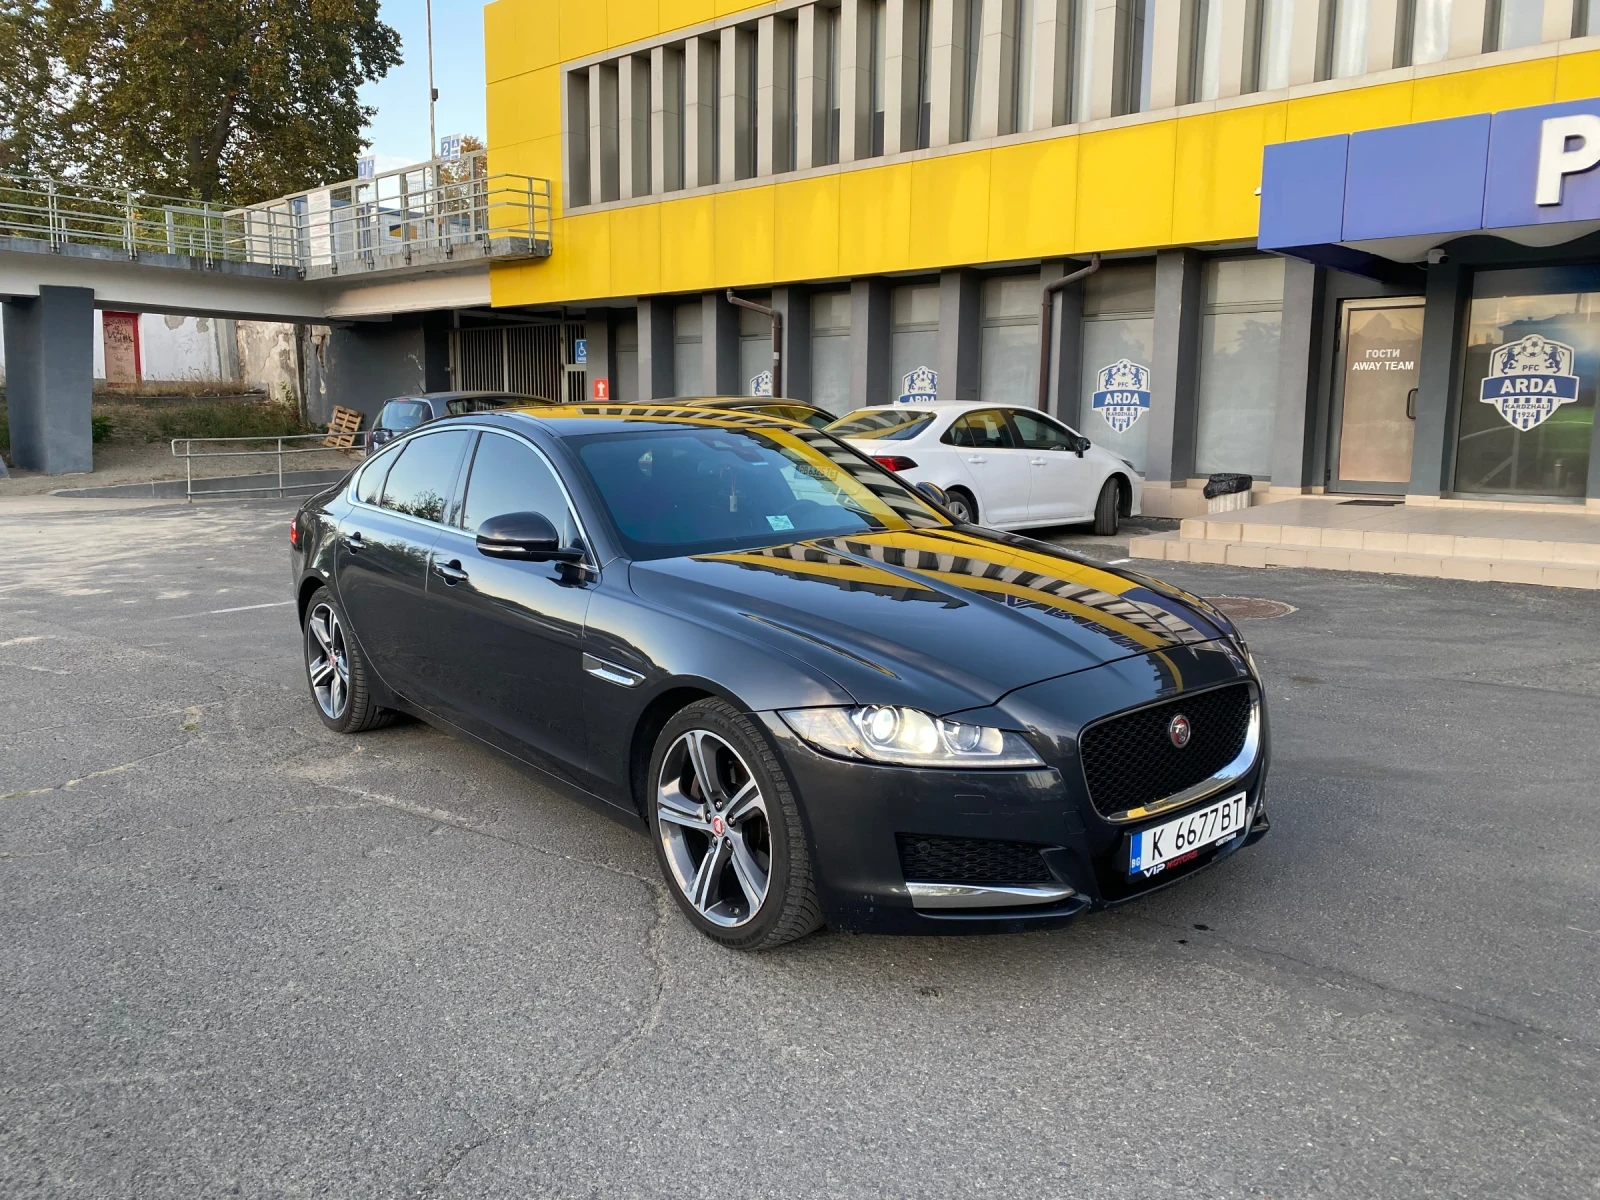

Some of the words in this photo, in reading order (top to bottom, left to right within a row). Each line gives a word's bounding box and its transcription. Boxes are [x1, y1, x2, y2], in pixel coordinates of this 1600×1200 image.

[442, 142, 449, 156] 2
[1535, 114, 1600, 207] P
[360, 162, 366, 176] 1
[1365, 348, 1401, 359] ГОСТИ
[1352, 361, 1383, 371] AWAY
[1384, 360, 1415, 371] TEAM
[1522, 364, 1540, 372] PFC
[1500, 378, 1557, 395] ARDA
[1104, 392, 1140, 405] ARDA
[1152, 828, 1165, 861] K
[1131, 857, 1141, 869] BG
[1143, 863, 1166, 878] VIP
[1166, 849, 1199, 870] MOTORS
